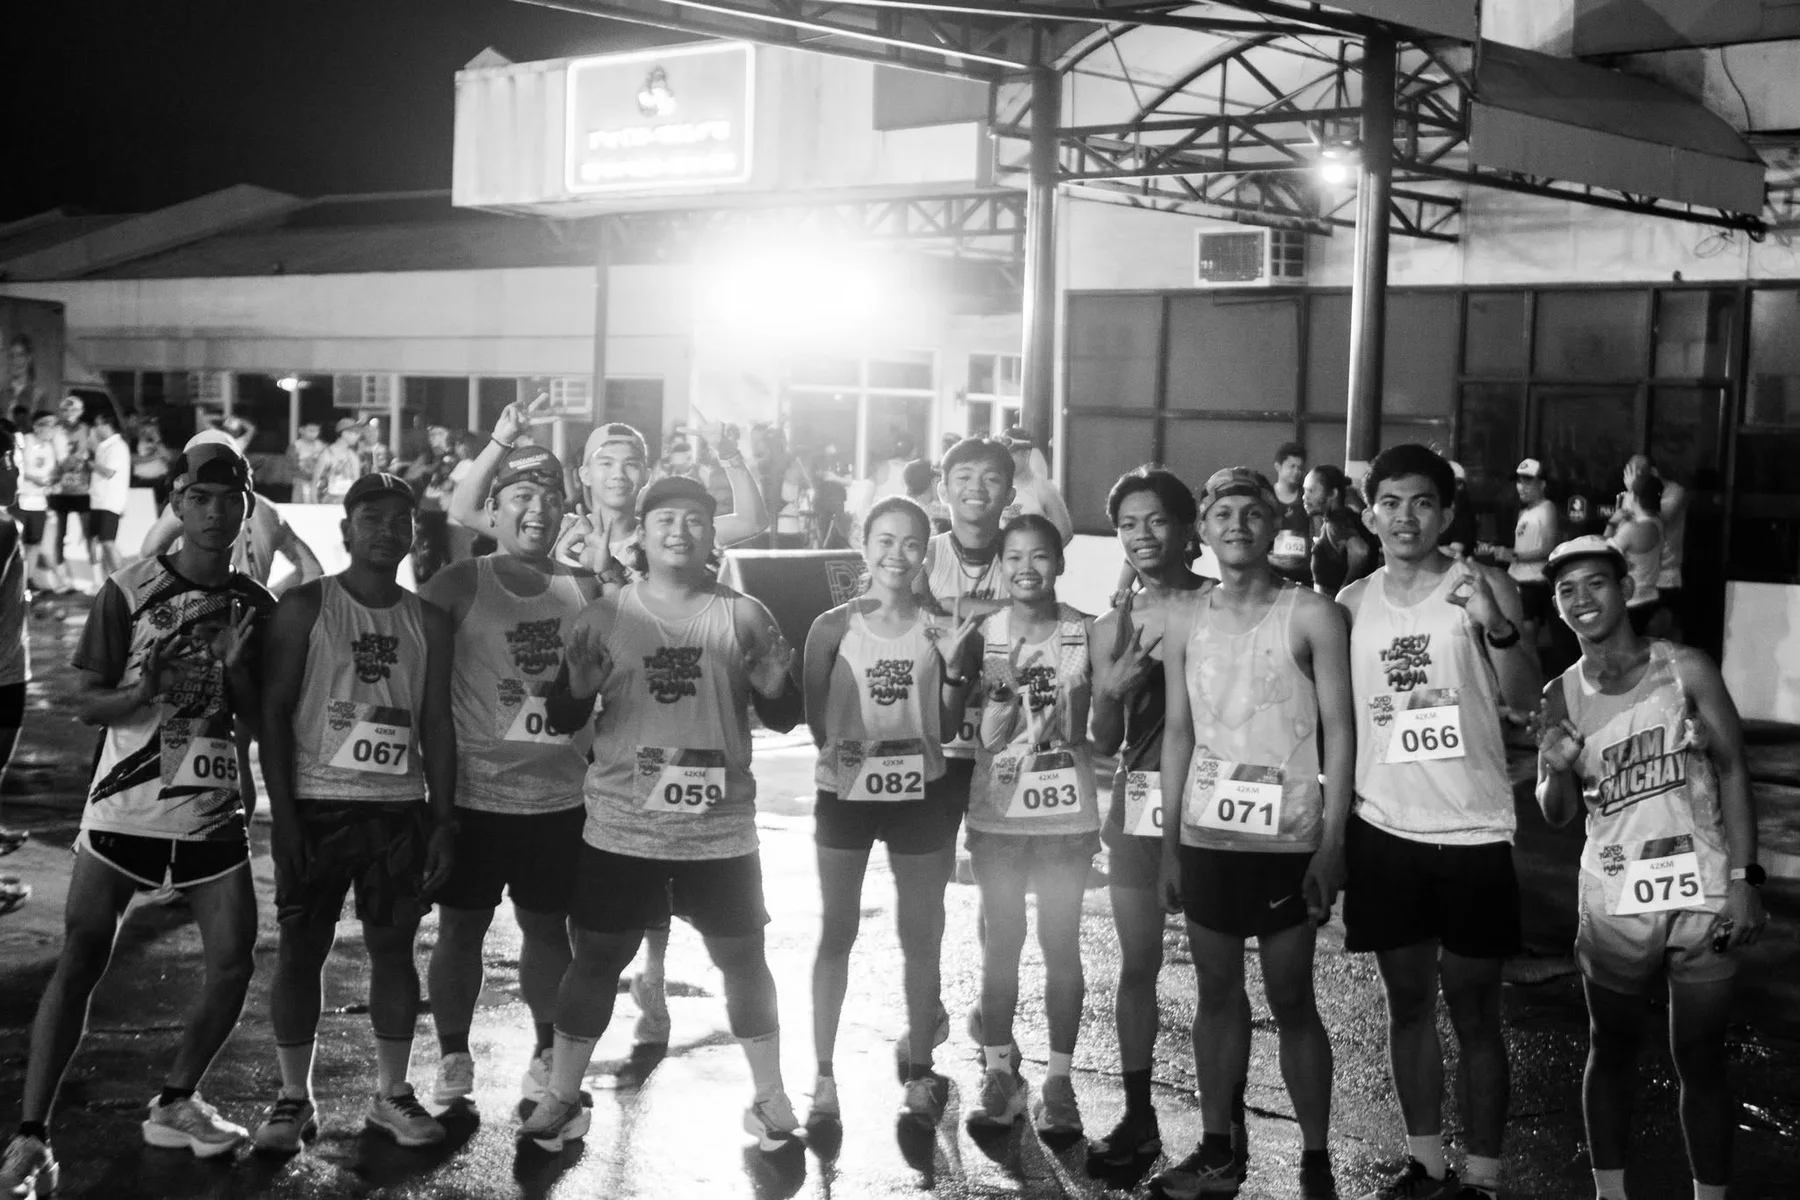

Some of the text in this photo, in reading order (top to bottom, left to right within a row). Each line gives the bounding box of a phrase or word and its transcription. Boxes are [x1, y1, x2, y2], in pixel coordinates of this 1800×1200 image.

[374, 727, 397, 736] 42KM
[1401, 725, 1459, 752] 066
[353, 738, 407, 766] 067
[193, 754, 238, 781] 065
[664, 783, 722, 807] 059
[866, 771, 922, 794] 082
[1023, 784, 1078, 809] 083
[1218, 798, 1273, 826] 071
[1649, 860, 1675, 870] 42KM
[1634, 872, 1699, 903] 075
